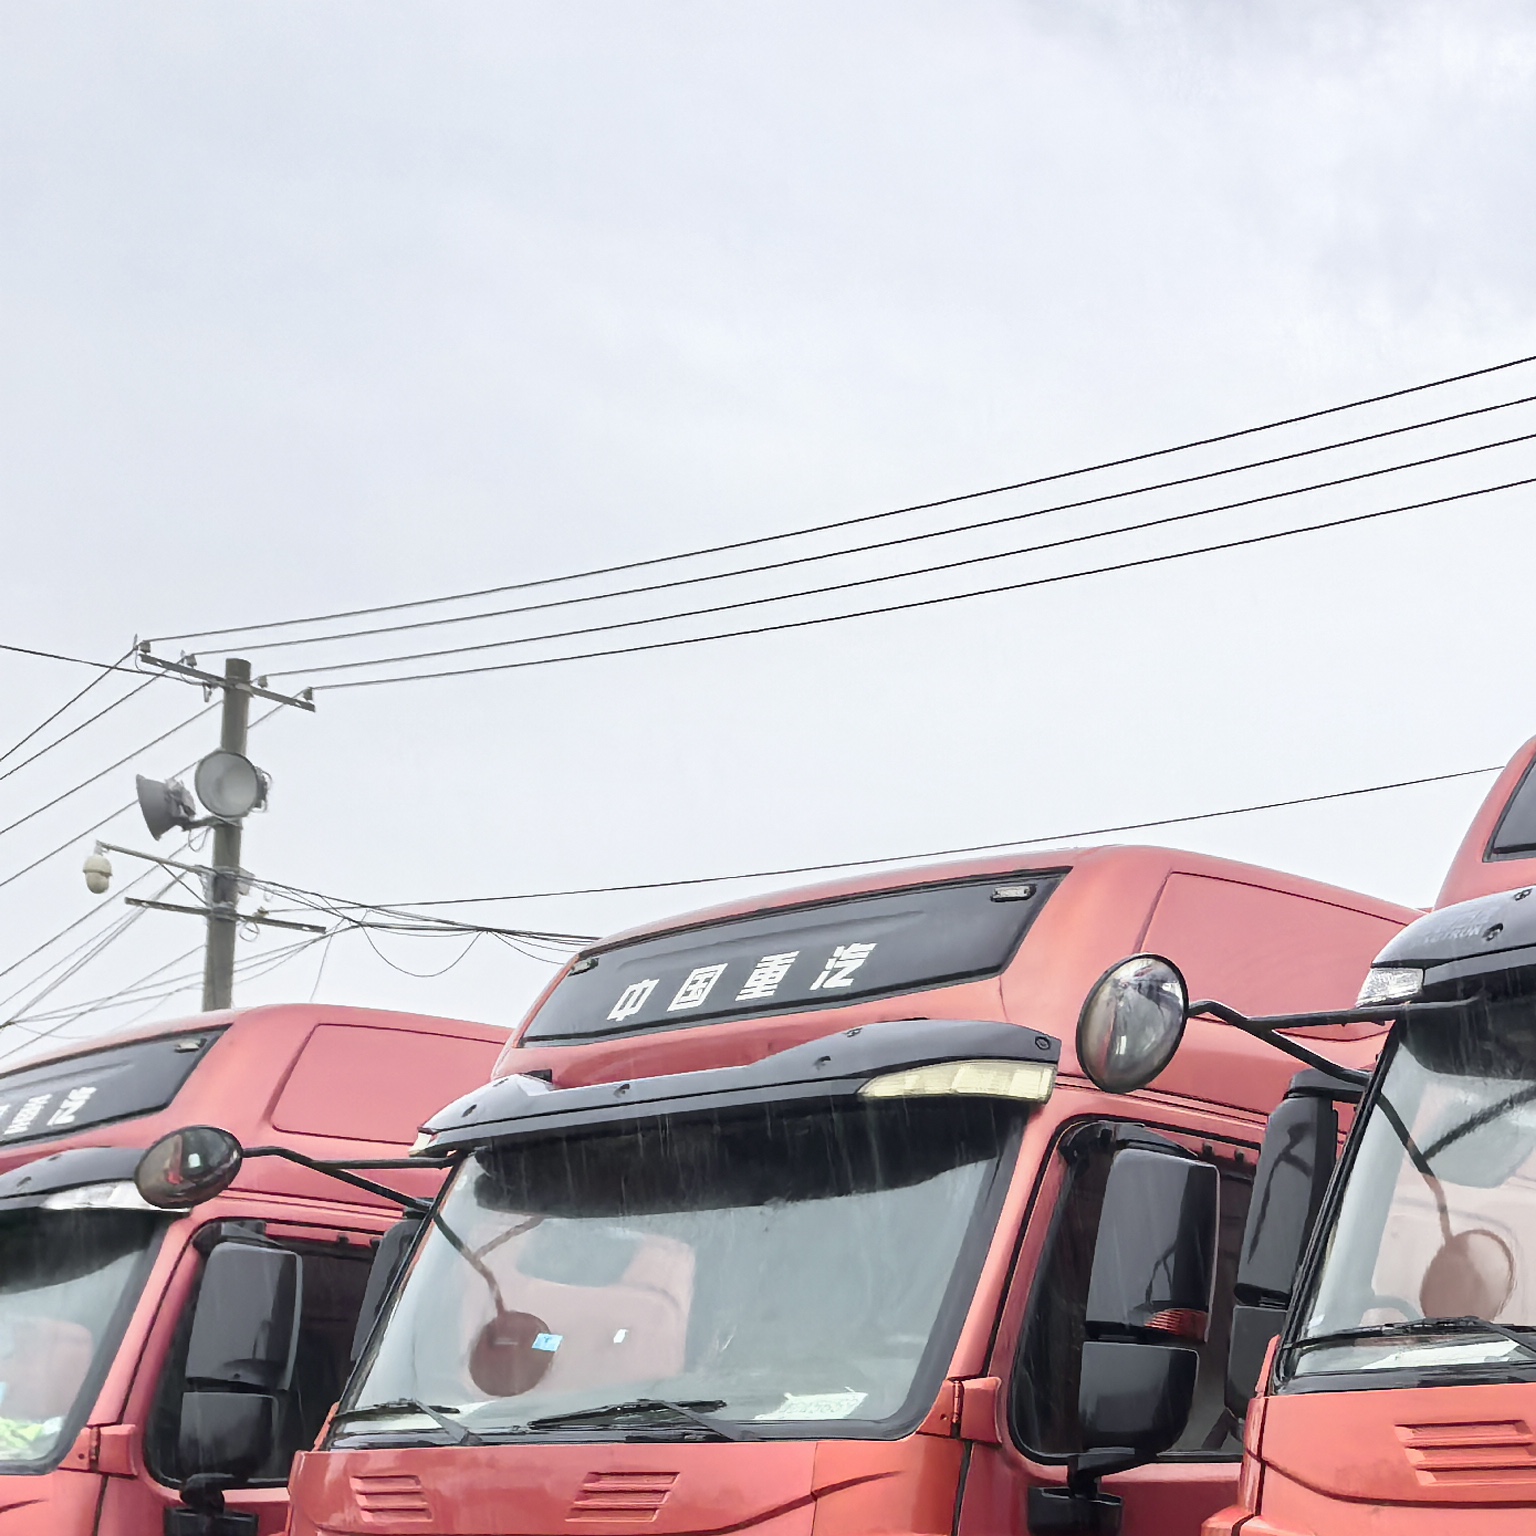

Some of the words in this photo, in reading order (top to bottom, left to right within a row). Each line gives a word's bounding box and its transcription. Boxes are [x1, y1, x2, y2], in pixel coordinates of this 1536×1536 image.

[607, 942, 877, 1022] 中国重汽
[0, 1086, 97, 1135] 重汽
